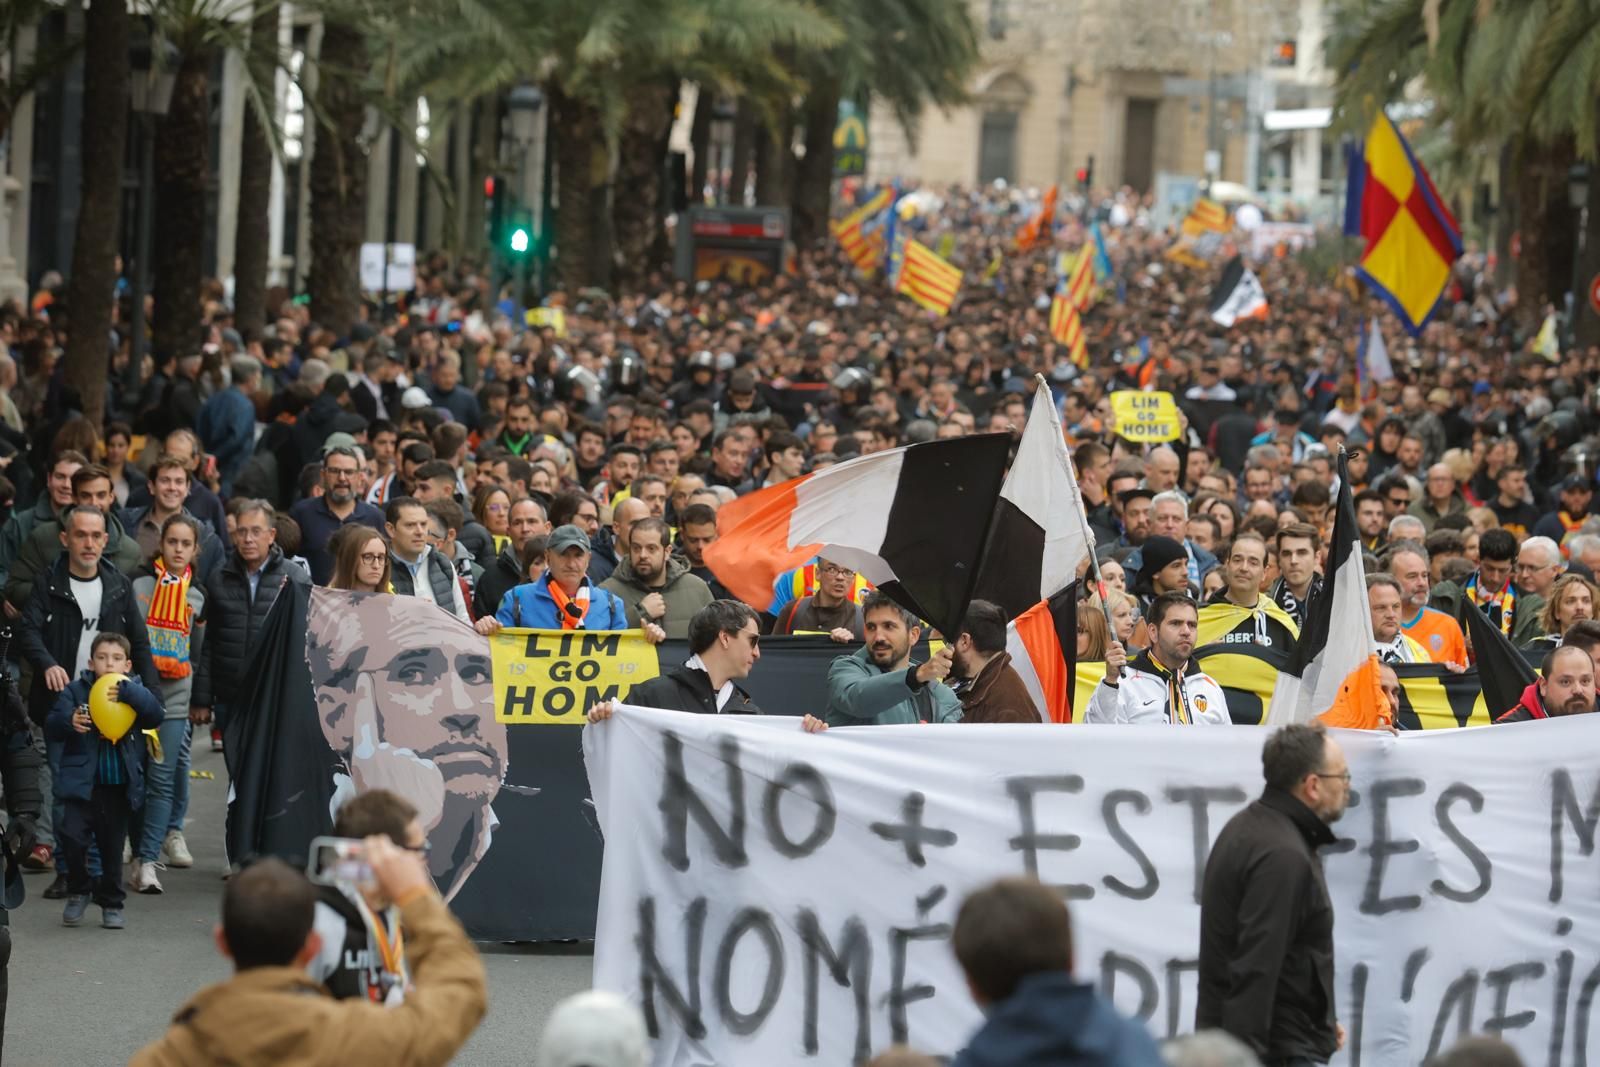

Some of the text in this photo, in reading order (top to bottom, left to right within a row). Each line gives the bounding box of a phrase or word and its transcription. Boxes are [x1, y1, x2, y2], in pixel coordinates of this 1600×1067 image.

[1132, 397, 1159, 408] LIM
[1137, 412, 1155, 421] GO
[1123, 424, 1169, 436] HOME
[525, 633, 621, 657] LIM
[549, 660, 600, 682] GO
[503, 684, 620, 716] HOM
[659, 730, 836, 872] NO
[870, 790, 958, 867] +
